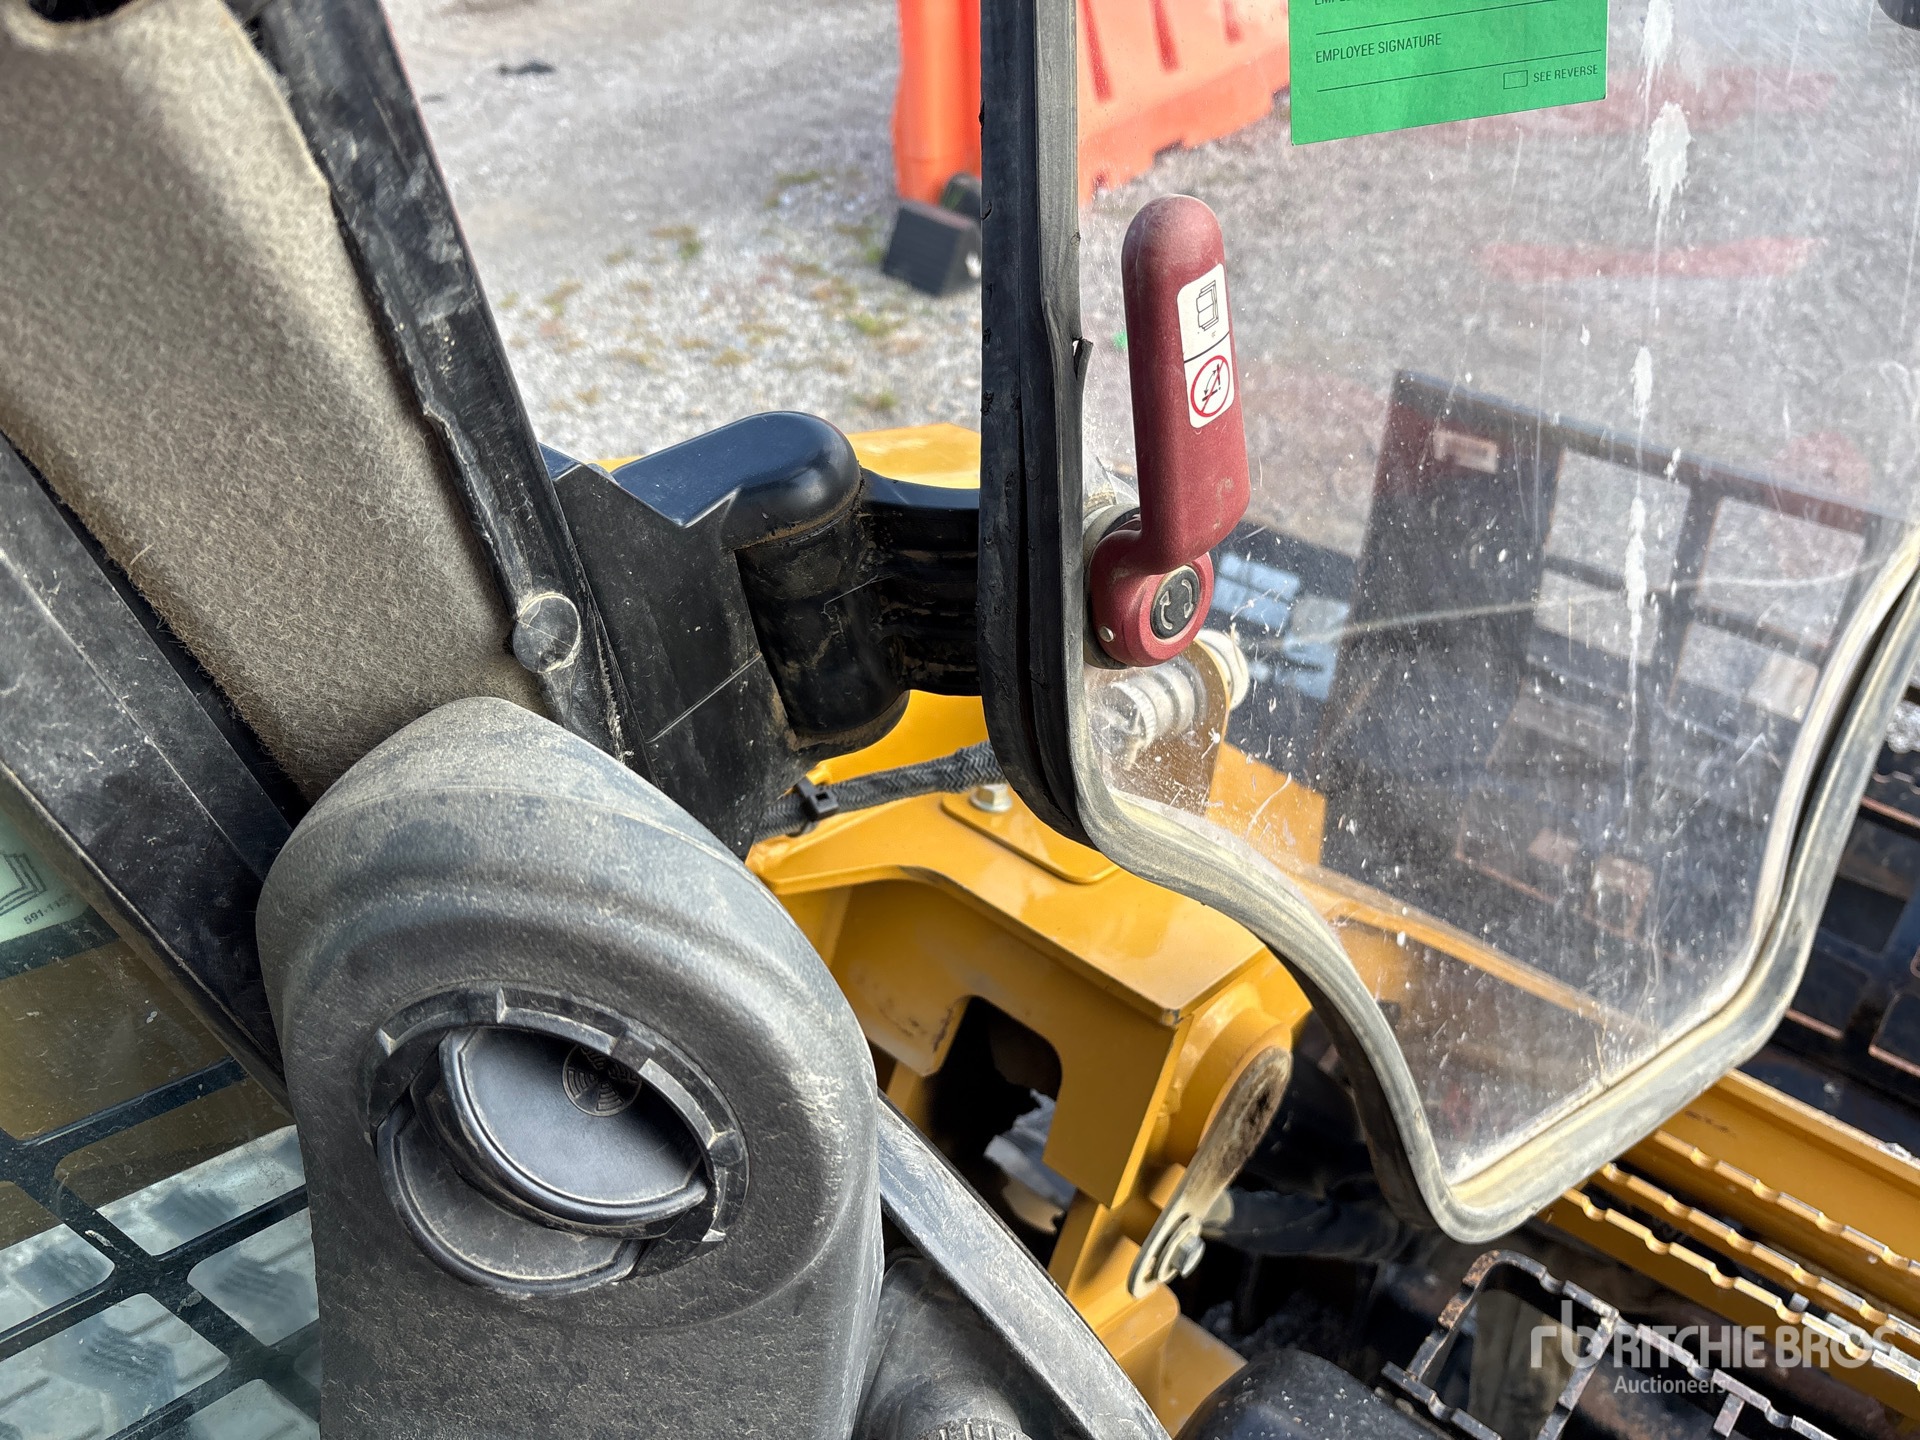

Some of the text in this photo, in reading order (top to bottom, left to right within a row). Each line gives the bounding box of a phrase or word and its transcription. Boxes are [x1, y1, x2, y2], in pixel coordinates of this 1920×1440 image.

[1315, 33, 1442, 64] EMPLOYEE SIGNATURE
[1533, 65, 1598, 83] SEE REVERSE
